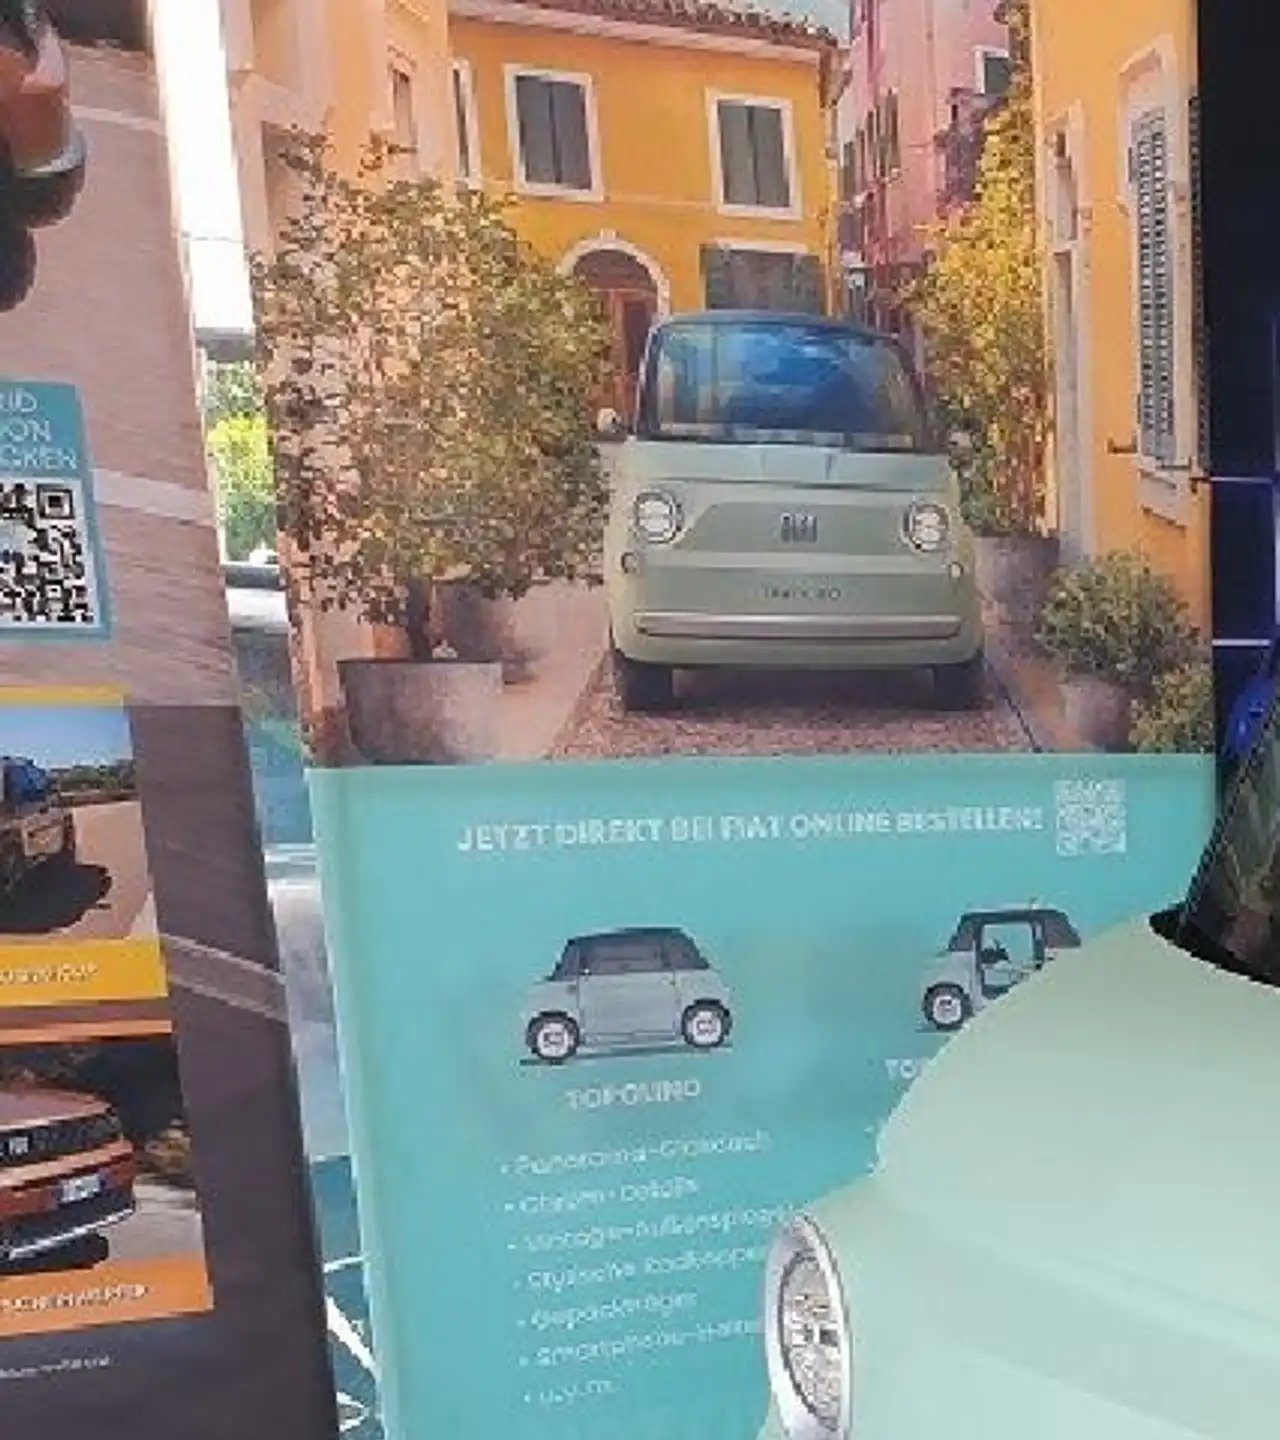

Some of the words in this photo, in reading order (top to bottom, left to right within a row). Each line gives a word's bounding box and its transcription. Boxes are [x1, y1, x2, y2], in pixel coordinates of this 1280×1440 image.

[456, 824, 551, 851] JETZT
[555, 817, 664, 845] DIREKT
[790, 812, 892, 839] ONLINE
